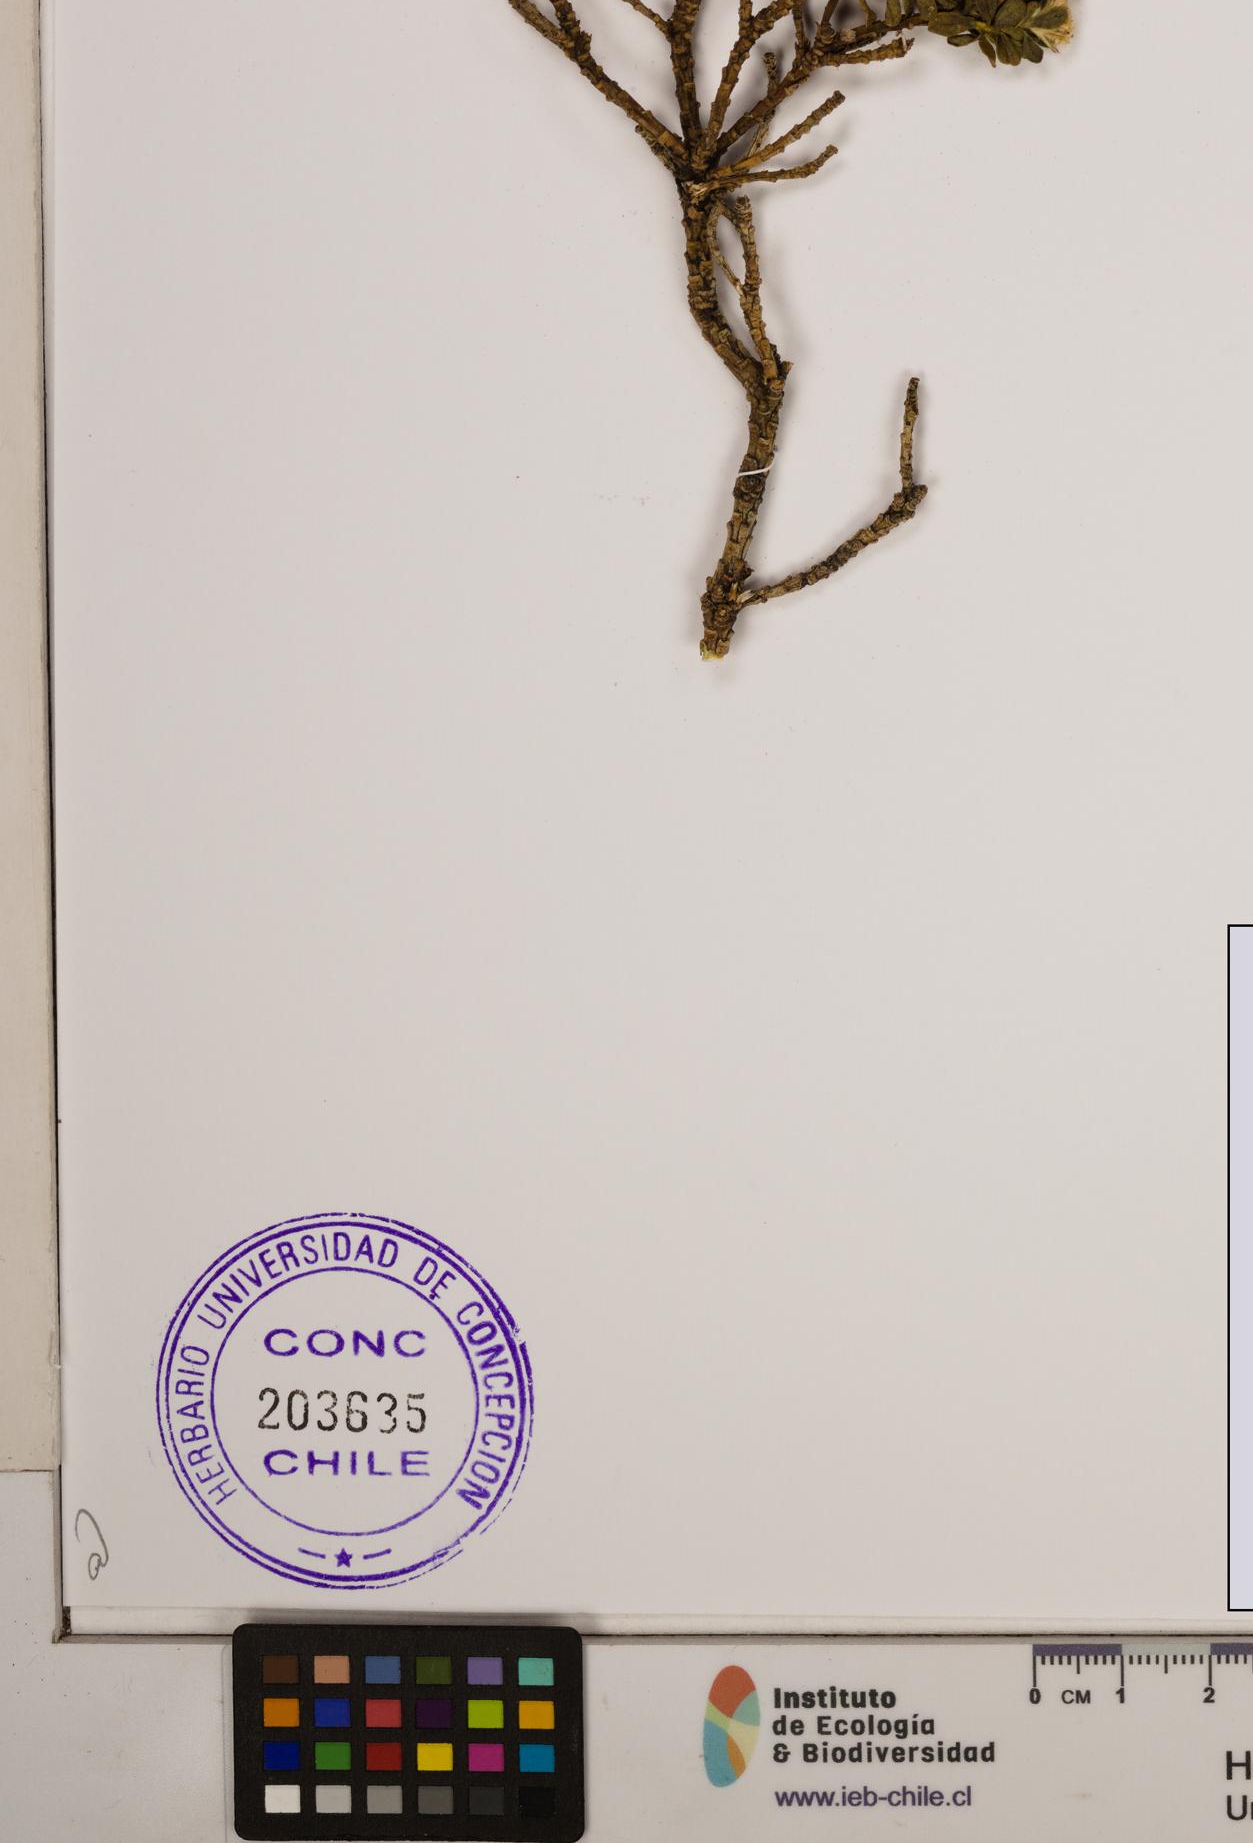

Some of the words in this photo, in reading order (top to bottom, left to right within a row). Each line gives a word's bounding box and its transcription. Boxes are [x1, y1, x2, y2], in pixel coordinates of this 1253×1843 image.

[197, 1231, 399, 1331] UNIVERSIDAD
[413, 1256, 458, 1300] DE
[263, 1328, 426, 1358] CONC
[257, 1387, 427, 1435] 203635
[455, 1301, 517, 1510] CONCEPCION
[174, 1345, 238, 1506] HERBARIO
[263, 1449, 430, 1476] CHILE
[773, 1685, 897, 1709] Instituto
[1029, 1686, 1042, 1705] 0
[1061, 1689, 1091, 1705] CM
[1115, 1687, 1126, 1704] 1
[1202, 1685, 1216, 1704] 2
[771, 1714, 805, 1736] de
[816, 1713, 935, 1740] Ecología
[772, 1742, 791, 1764] &
[802, 1740, 995, 1764] Biodiversidad
[774, 1785, 972, 1807] www.ieb-chile.cl
